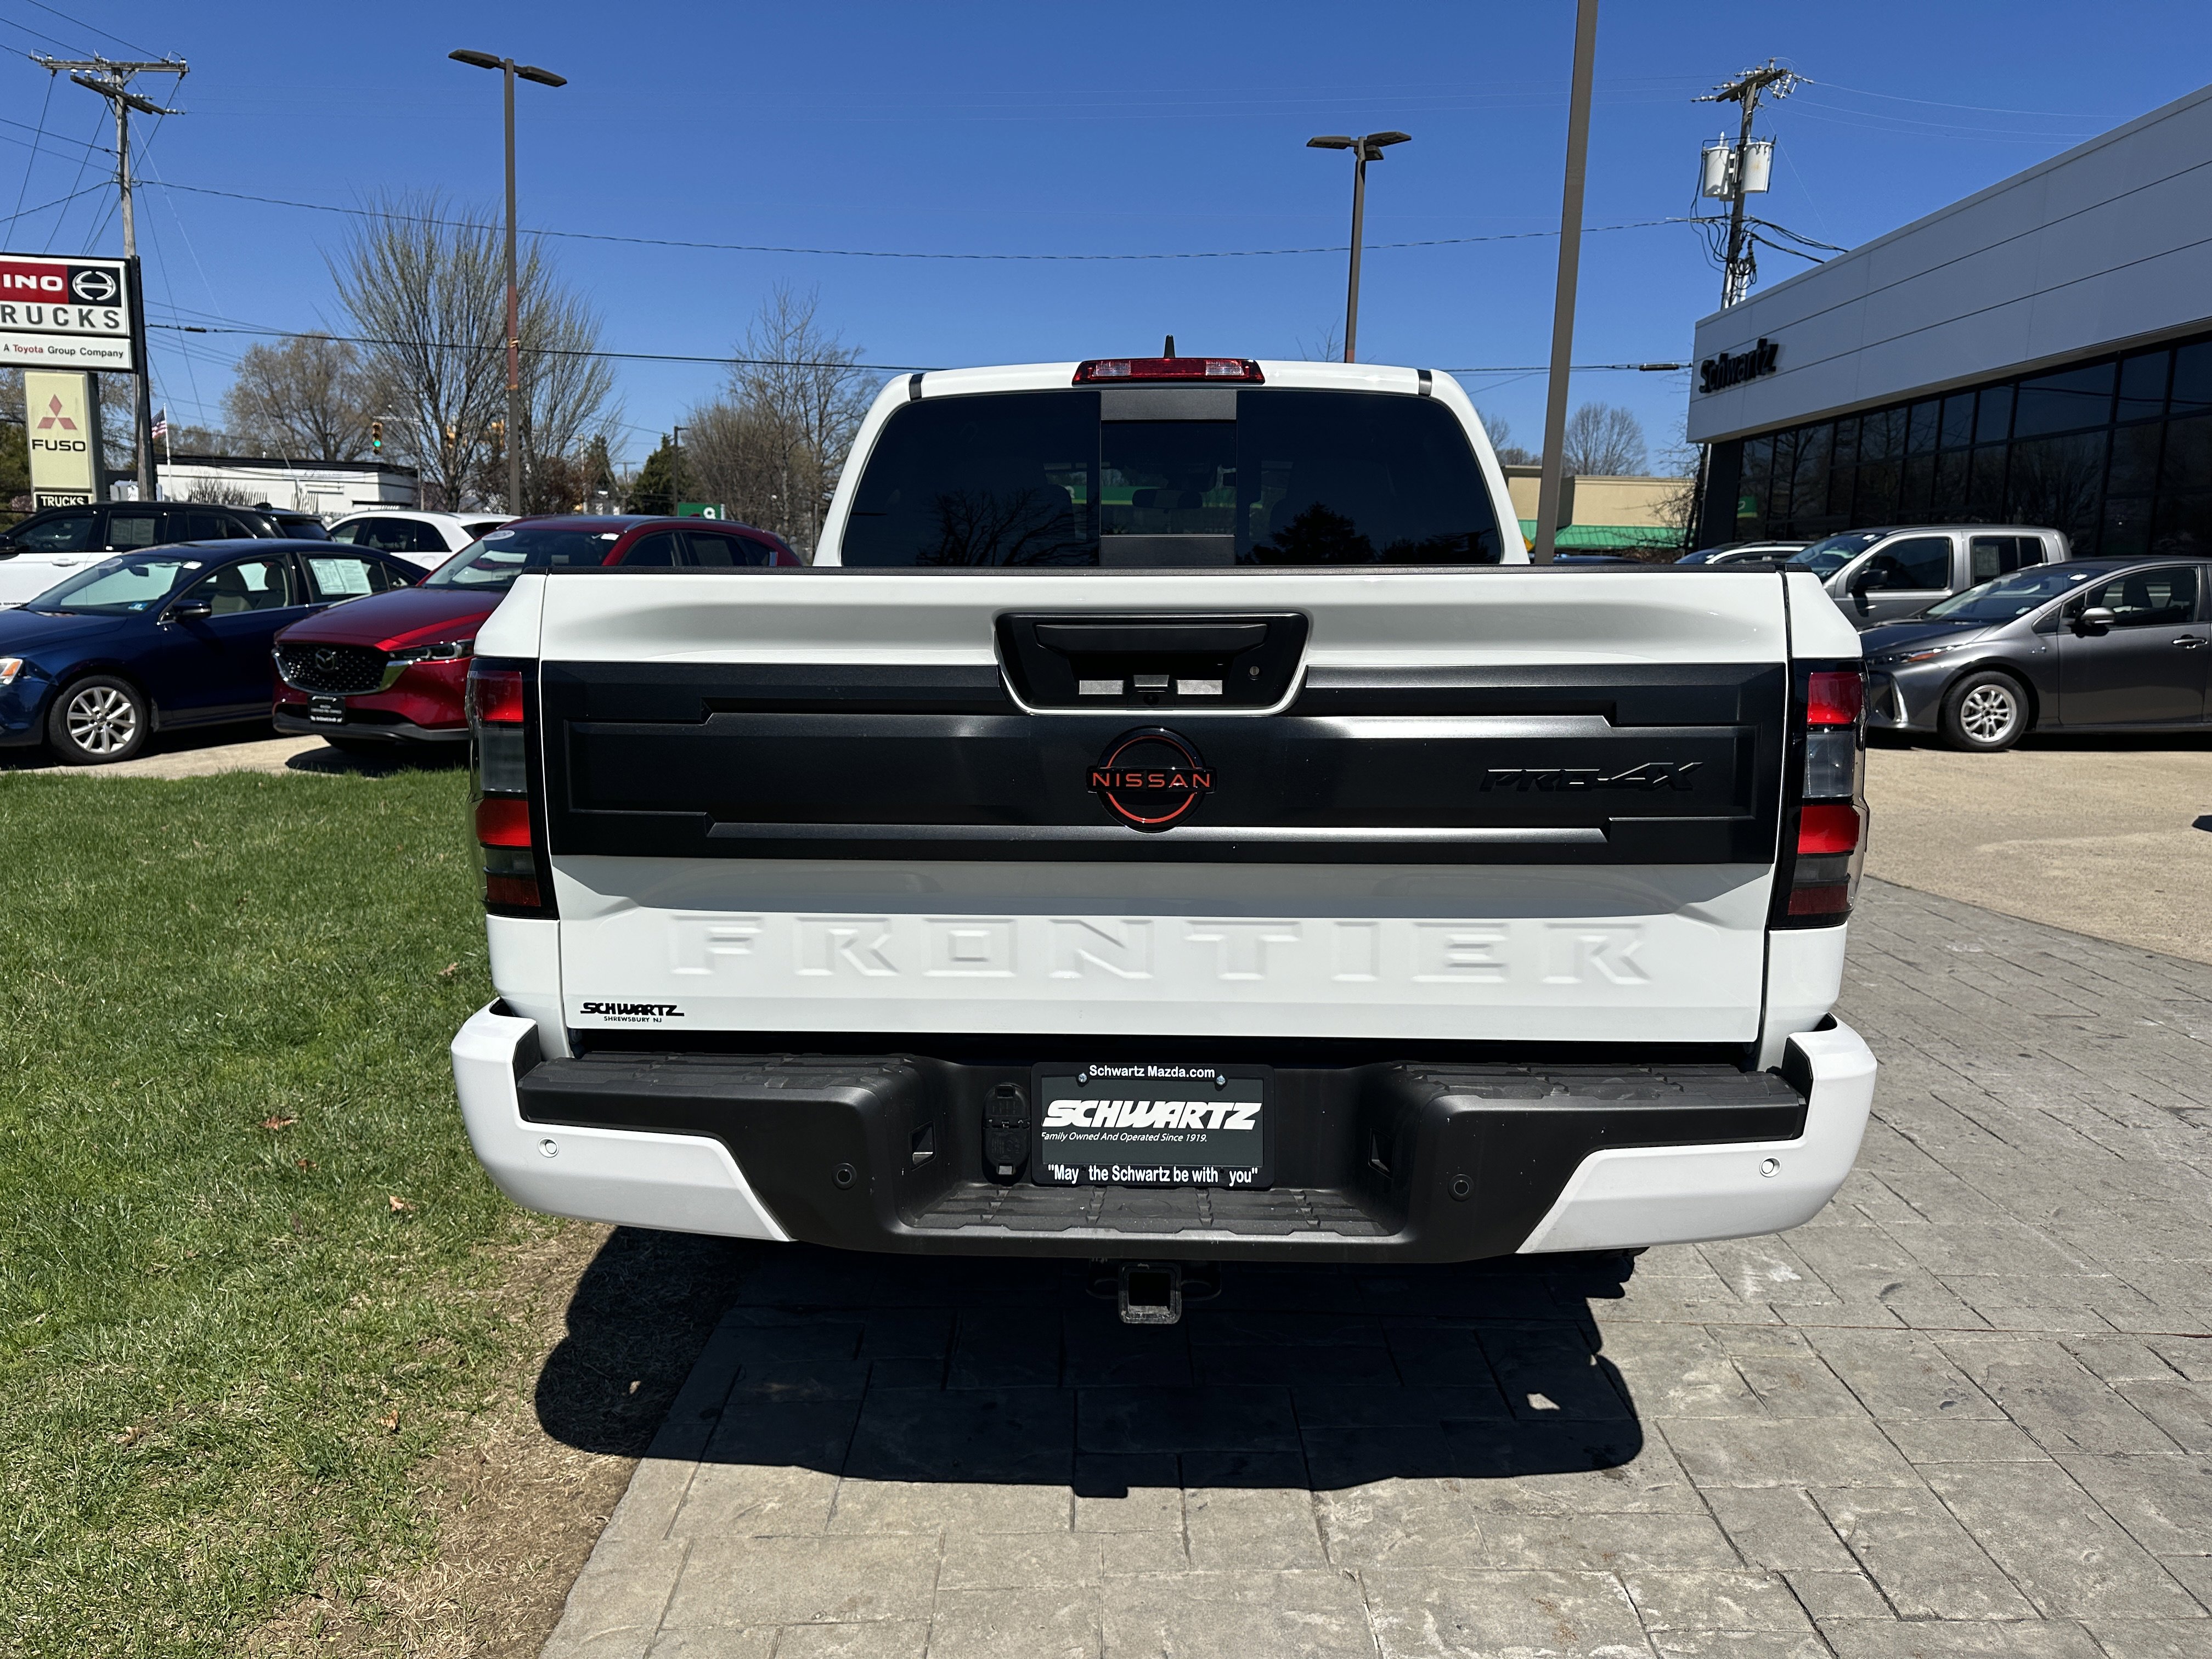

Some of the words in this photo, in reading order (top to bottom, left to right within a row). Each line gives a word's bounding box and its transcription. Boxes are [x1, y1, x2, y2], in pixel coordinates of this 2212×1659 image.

[3, 343, 9, 352] A
[13, 344, 43, 354] Toyota
[48, 346, 76, 356] Group
[80, 347, 123, 358] Company
[1699, 338, 1779, 393] Schwartz
[32, 439, 86, 452] FUSO
[41, 495, 84, 507] TRUCKS
[1092, 772, 1210, 788] NISSAN
[1480, 762, 1703, 792] PRO-4X
[667, 915, 1651, 984] FRONTIER
[580, 1002, 685, 1016] SCHWARTZ
[1089, 1065, 1144, 1077] Schwartz
[1148, 1066, 1215, 1078] Mazda.com
[1042, 1099, 1262, 1130] SCHWARTZ
[1069, 1132, 1099, 1141] Owned
[1101, 1132, 1119, 1141] And
[1120, 1132, 1159, 1143] Operated
[1160, 1133, 1184, 1142] Since
[1048, 1164, 1079, 1184] "May
[1088, 1165, 1109, 1181] the
[1111, 1165, 1171, 1182] Schwartz
[1173, 1166, 1189, 1182] be
[1192, 1166, 1218, 1183] with
[1229, 1167, 1258, 1187] you"
